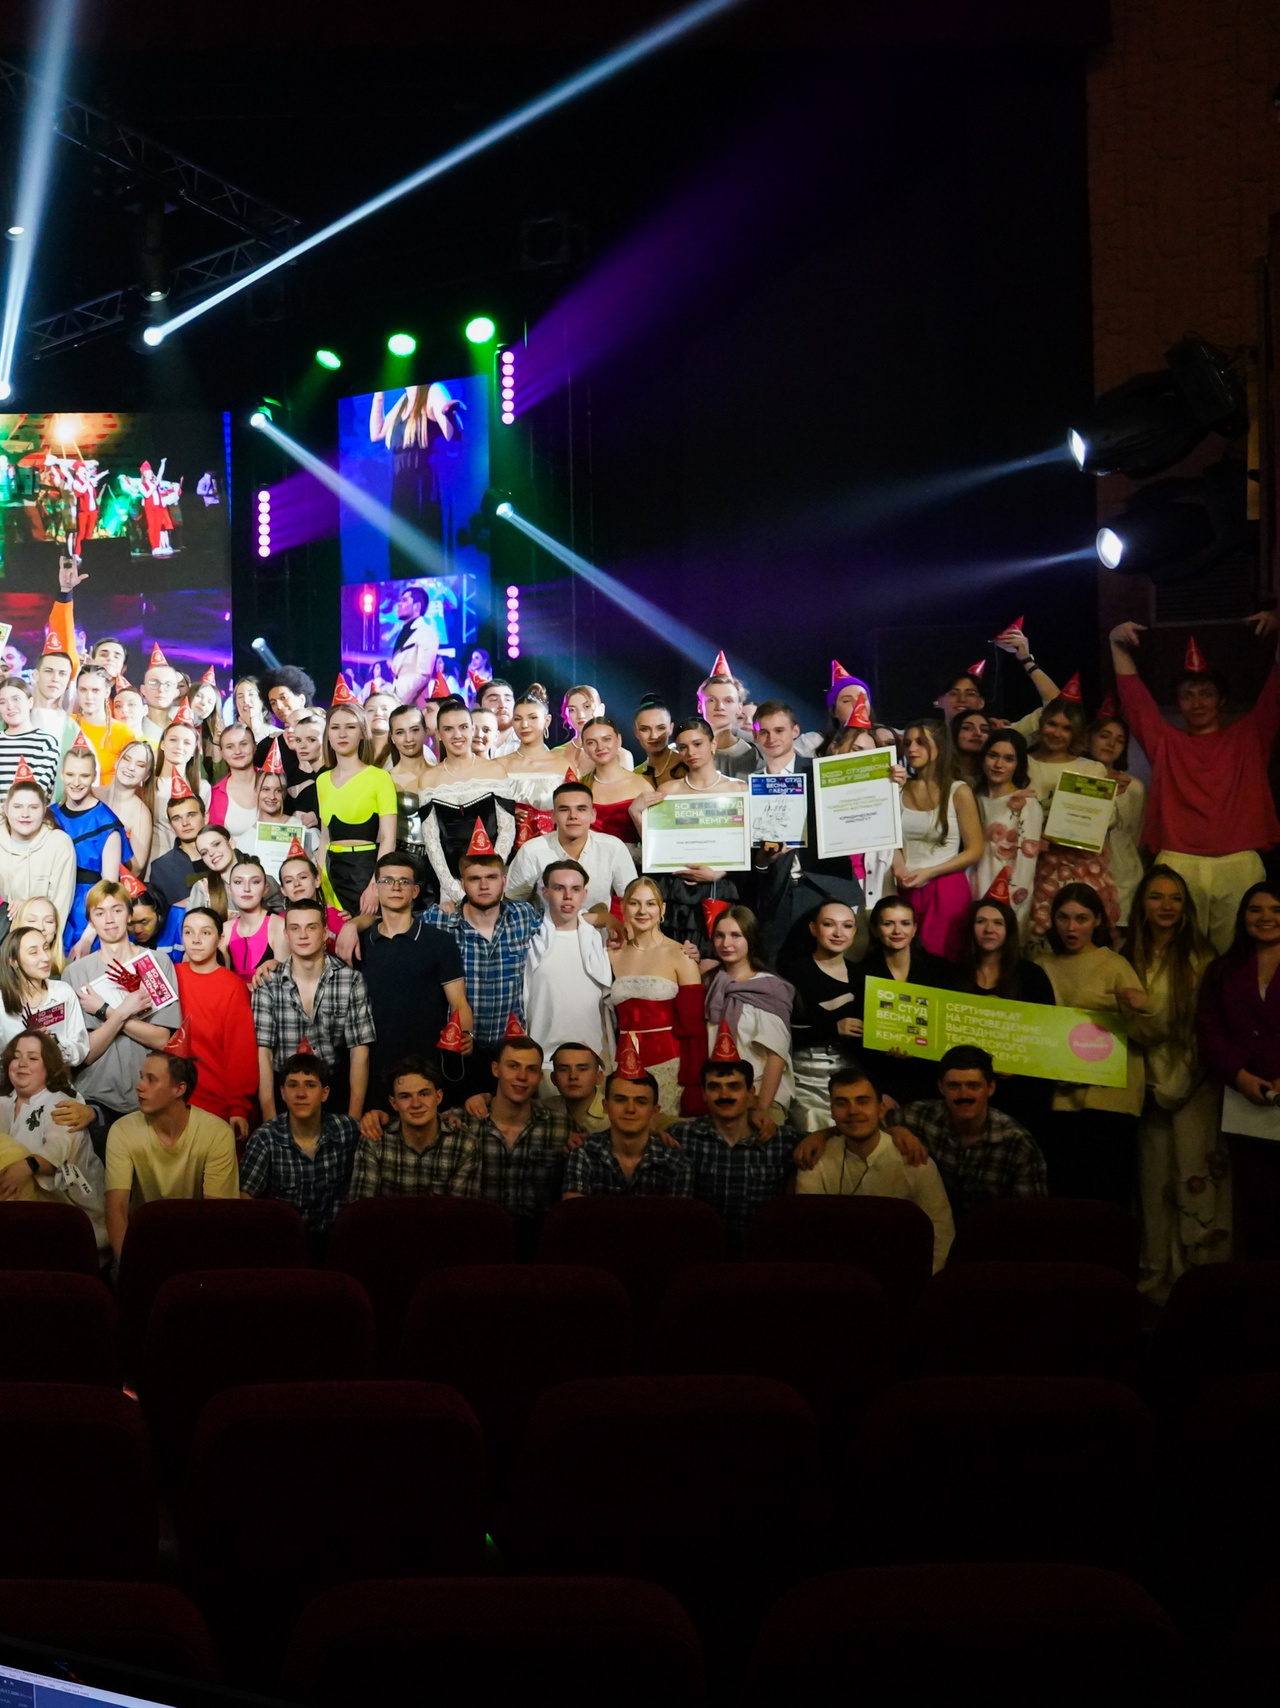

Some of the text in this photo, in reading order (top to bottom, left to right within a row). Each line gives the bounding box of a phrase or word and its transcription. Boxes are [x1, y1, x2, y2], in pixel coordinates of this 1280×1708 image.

[674, 809, 705, 818] ВЕСНА
[877, 989, 895, 1000] 50
[876, 1010, 913, 1023] ВЕСНА
[898, 1003, 928, 1018] СТУД
[946, 1002, 1022, 1021] СЕРТИФИКАТ
[946, 1013, 1041, 1034] НА ПРОВЕДЕНИЕ
[920, 1028, 927, 1037] В
[946, 1023, 1010, 1040] ВЫЕЗДНОЙ
[1012, 1034, 1059, 1047] ШКОЛЫ
[946, 1033, 1027, 1053] ТВОРЧЕСКОГО
